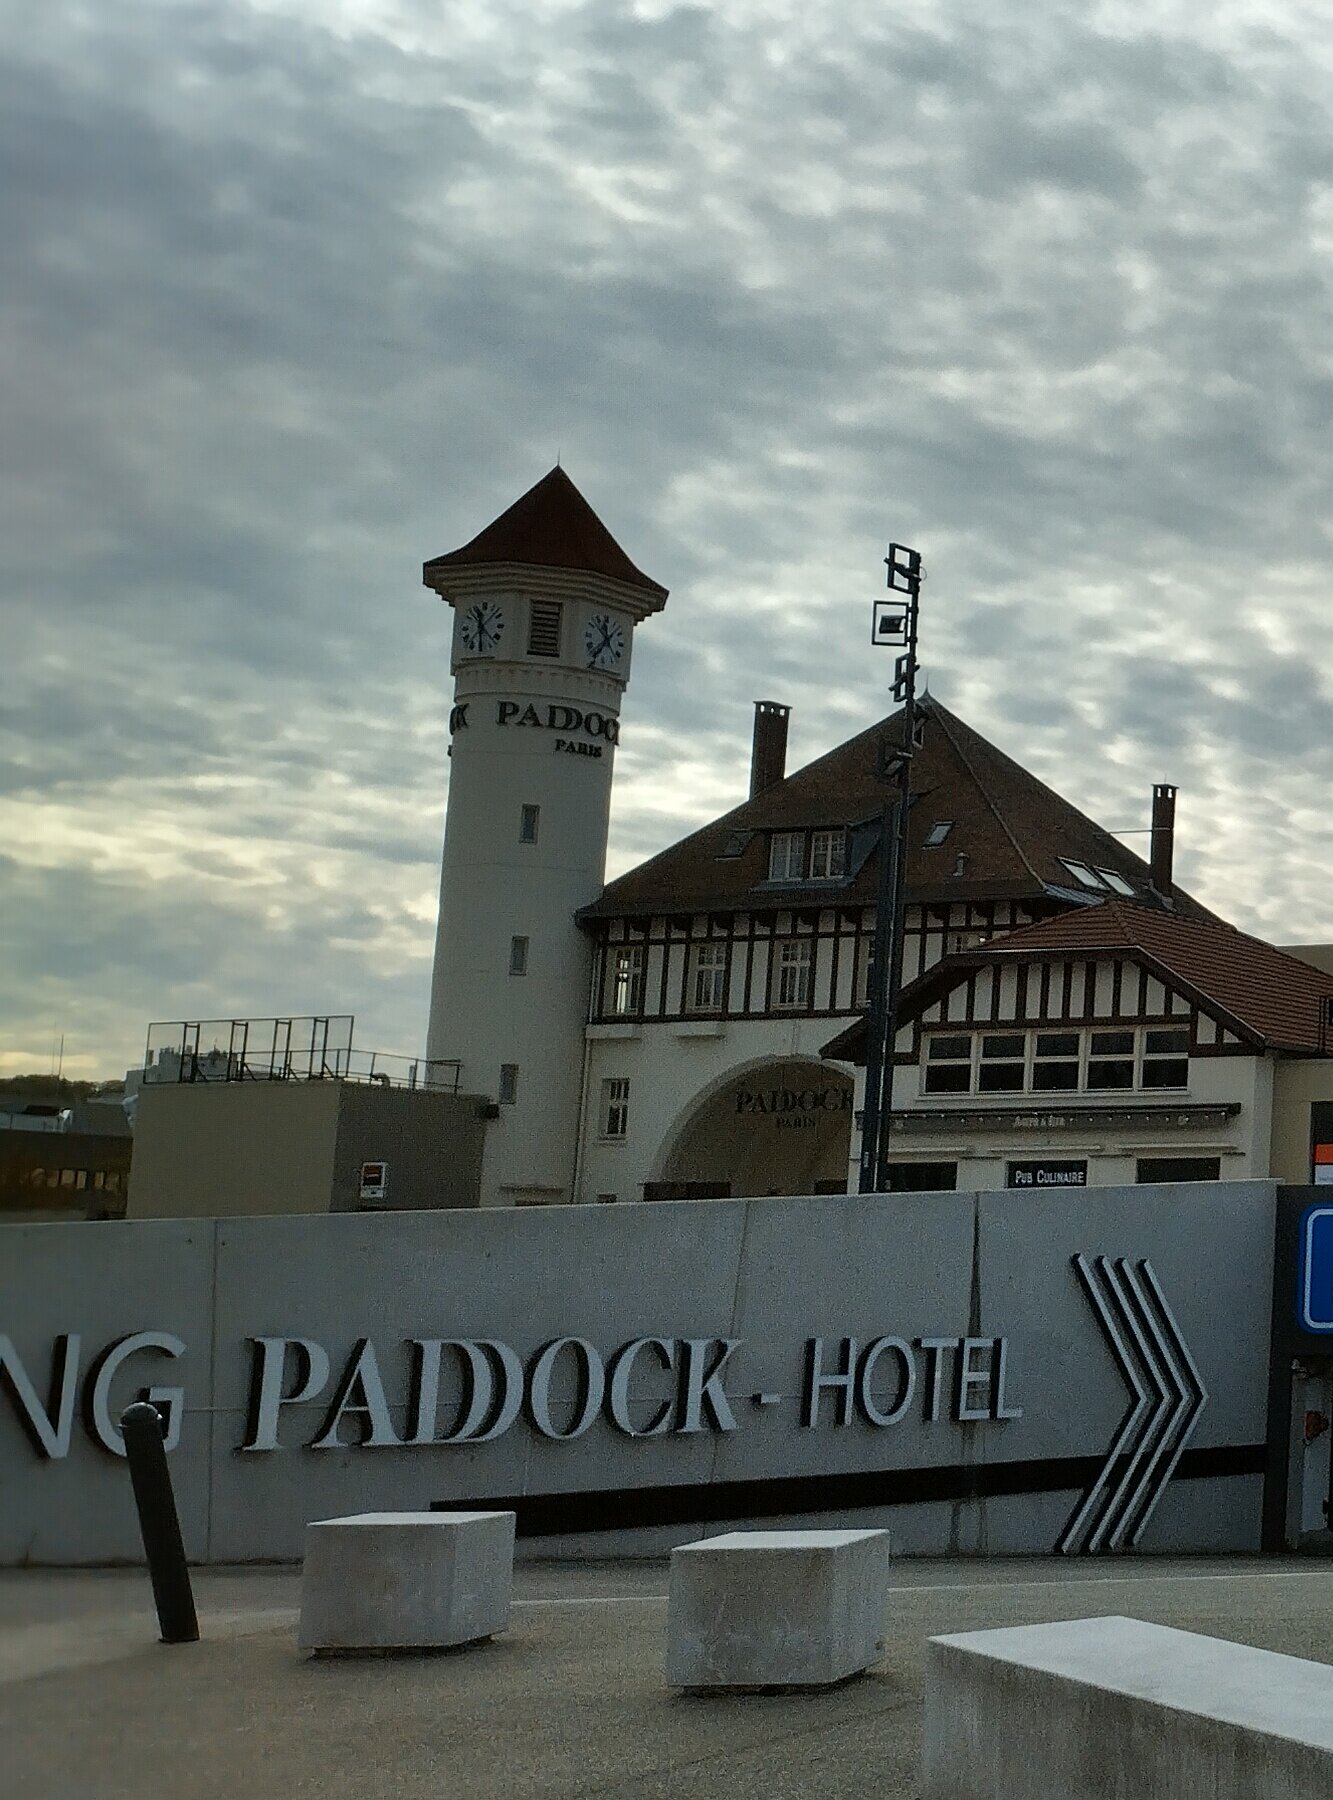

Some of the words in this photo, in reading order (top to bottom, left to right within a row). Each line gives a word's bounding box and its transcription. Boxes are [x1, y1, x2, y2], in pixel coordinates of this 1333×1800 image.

[496, 700, 620, 746] PADDOC
[555, 739, 602, 758] PARIS
[236, 1335, 739, 1453] PADDOCK
[802, 1335, 1023, 1427] HOTEL
